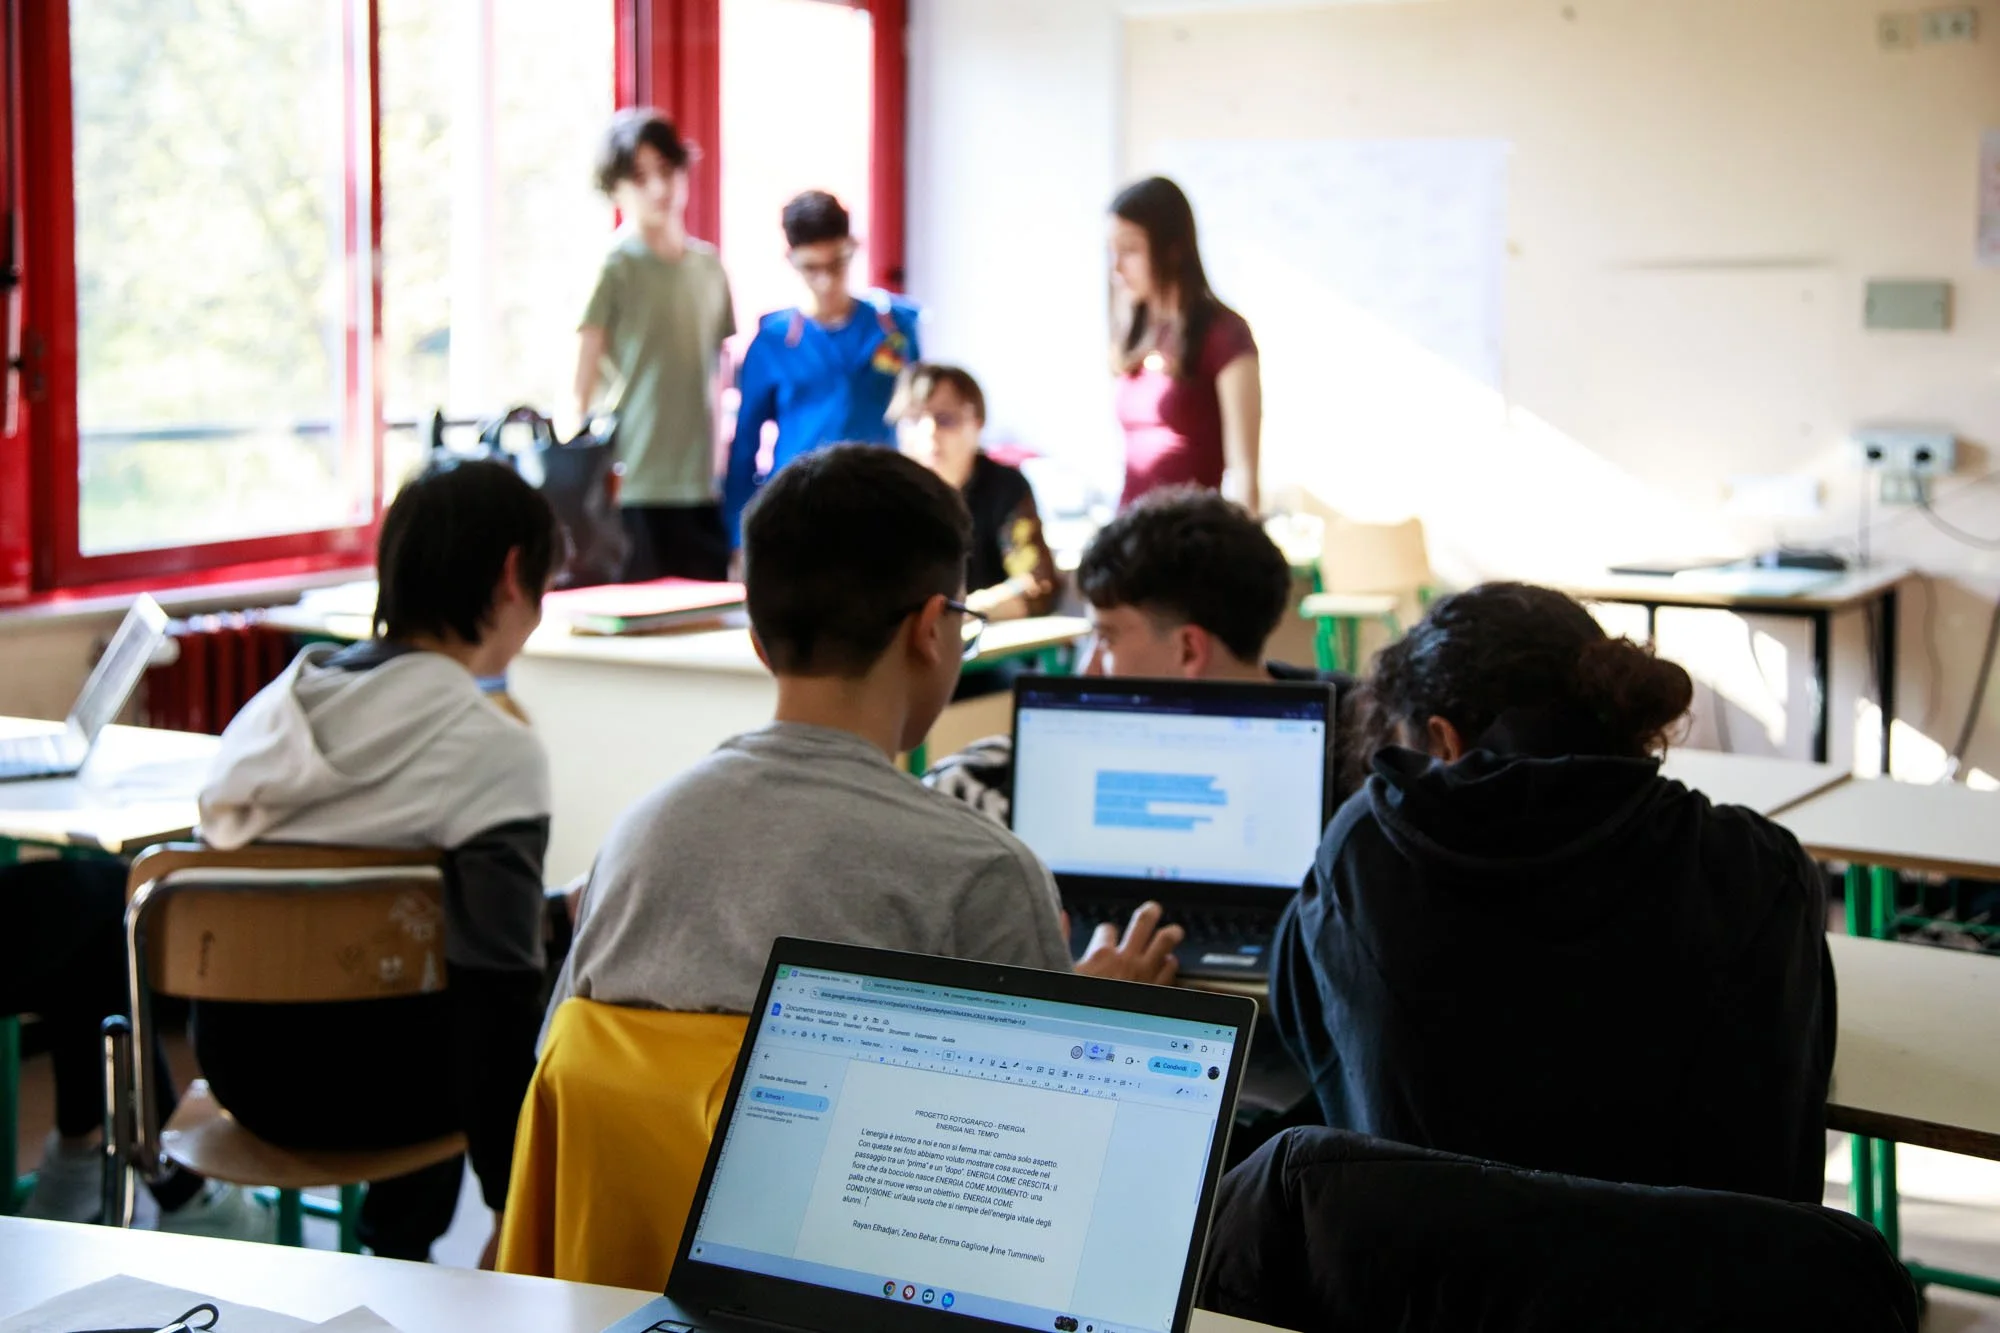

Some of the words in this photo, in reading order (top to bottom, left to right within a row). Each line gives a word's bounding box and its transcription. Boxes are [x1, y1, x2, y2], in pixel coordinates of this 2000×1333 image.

[915, 1110, 948, 1120] PROGETTO
[949, 1116, 993, 1128] FOTOGRAFICO
[998, 1123, 1025, 1133] ENERGIA
[936, 1123, 962, 1132] ENERGIA
[978, 1130, 999, 1139] TEMPO
[858, 1139, 870, 1147] Con
[872, 1143, 892, 1151] queste
[904, 1147, 916, 1155] foto
[917, 1150, 944, 1160] abbiamo
[946, 1155, 964, 1163] voluto
[966, 1159, 994, 1169] mostrare
[1012, 1167, 1039, 1176] succede
[861, 1128, 888, 1139] L'energia
[894, 1134, 916, 1143] intorno
[958, 1144, 977, 1154] ferma
[993, 1152, 1016, 1161] cambia
[1033, 1159, 1057, 1168] aspetto.
[852, 1161, 865, 1170] fiore
[867, 1164, 878, 1172] che
[888, 1168, 914, 1178] bocciolo
[915, 1174, 934, 1182] nasce
[935, 1176, 963, 1187] ENERGIA
[965, 1181, 985, 1191] COME
[855, 1152, 886, 1162] passaggio
[907, 1159, 928, 1168] "prima"
[967, 1169, 994, 1180] ENERGIA
[997, 1175, 1016, 1184] COME
[884, 1180, 904, 1188] muove
[963, 1193, 991, 1204] ENERGIA
[993, 1198, 1013, 1208] COME
[894, 1193, 915, 1202] un'aula
[935, 1200, 947, 1208] che
[955, 1204, 978, 1214] riempie
[980, 1208, 1015, 1221] dell'energia
[1017, 1215, 1034, 1224] vitale
[1035, 1218, 1052, 1228] degli
[853, 1220, 871, 1230] Rayan
[901, 1229, 917, 1239] Zeno
[939, 1236, 959, 1246] Emma
[961, 1240, 989, 1252] Gaglione
[1008, 1249, 1044, 1263] Tumminello
